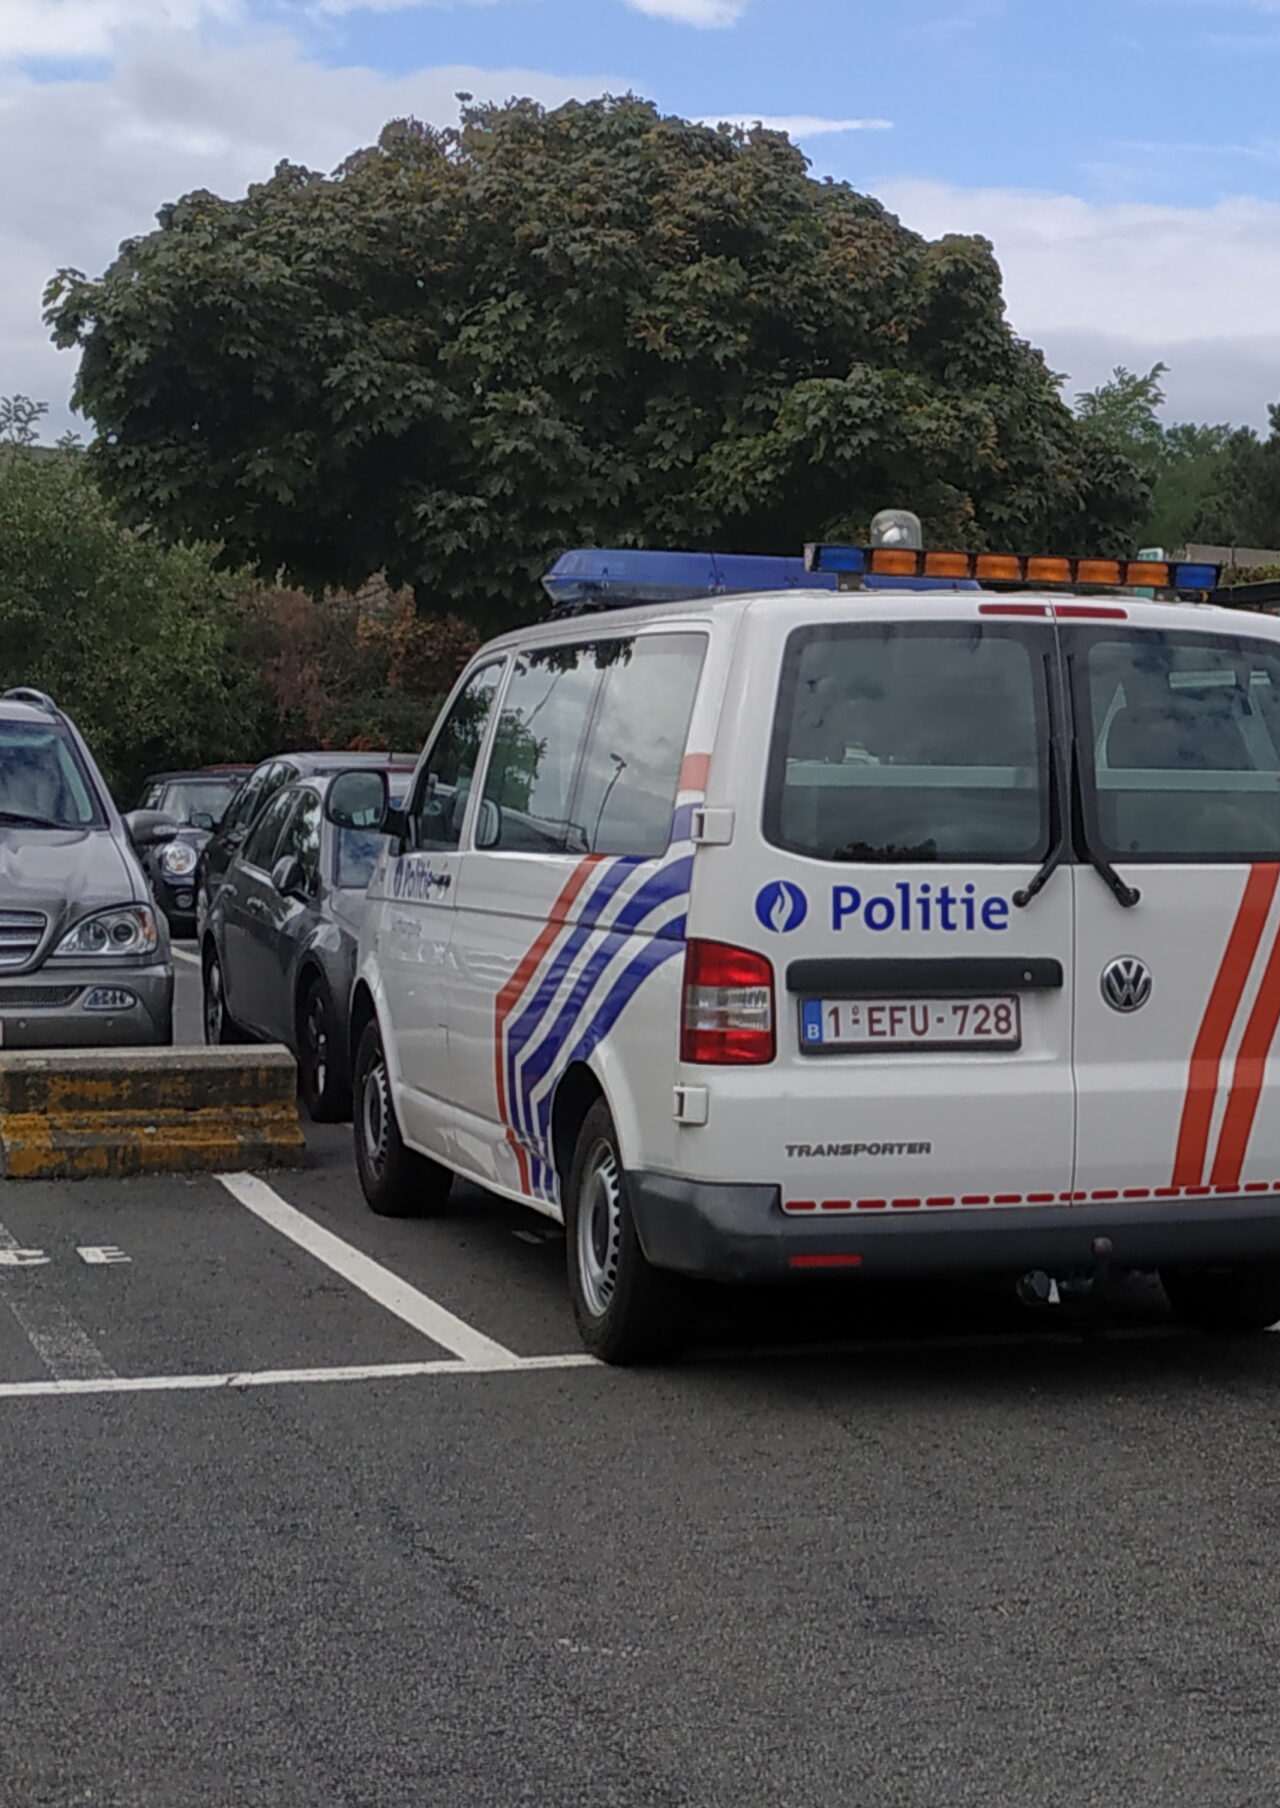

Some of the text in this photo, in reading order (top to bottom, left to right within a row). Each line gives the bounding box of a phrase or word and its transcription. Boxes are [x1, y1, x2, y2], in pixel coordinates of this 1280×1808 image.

[832, 882, 1009, 931] Politie
[807, 1024, 819, 1039] B
[785, 1142, 931, 1158] TRANSPORTER
